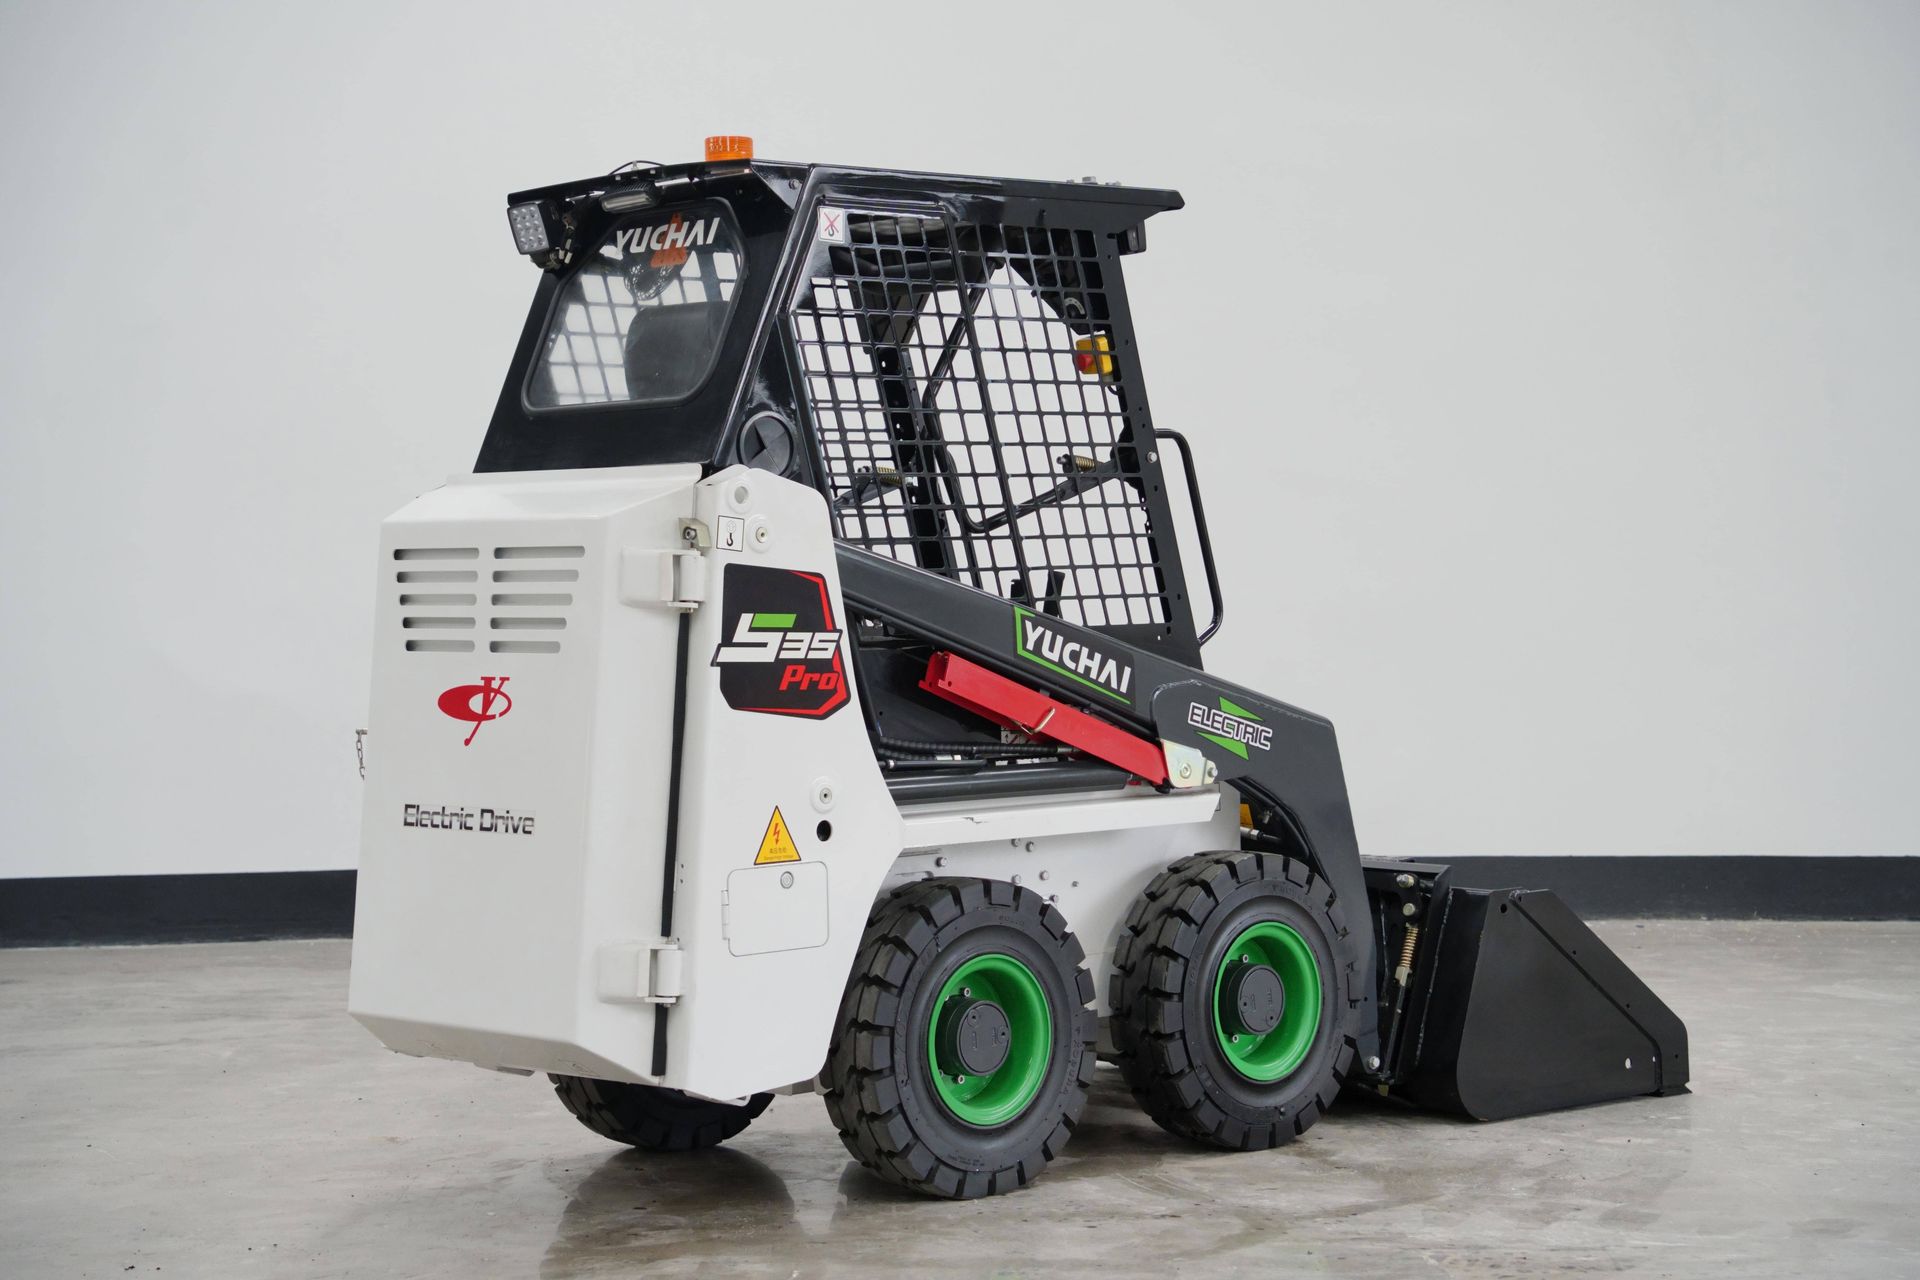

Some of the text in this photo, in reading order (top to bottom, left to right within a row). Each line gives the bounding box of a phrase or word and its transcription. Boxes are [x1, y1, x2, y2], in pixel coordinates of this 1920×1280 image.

[614, 216, 720, 254] YUCHAI
[716, 612, 841, 663] S35
[1024, 619, 1132, 694] YUCHAI
[778, 664, 840, 691] Pro
[1187, 701, 1273, 751] ELECTRIC
[403, 803, 535, 835] Electric Drive
